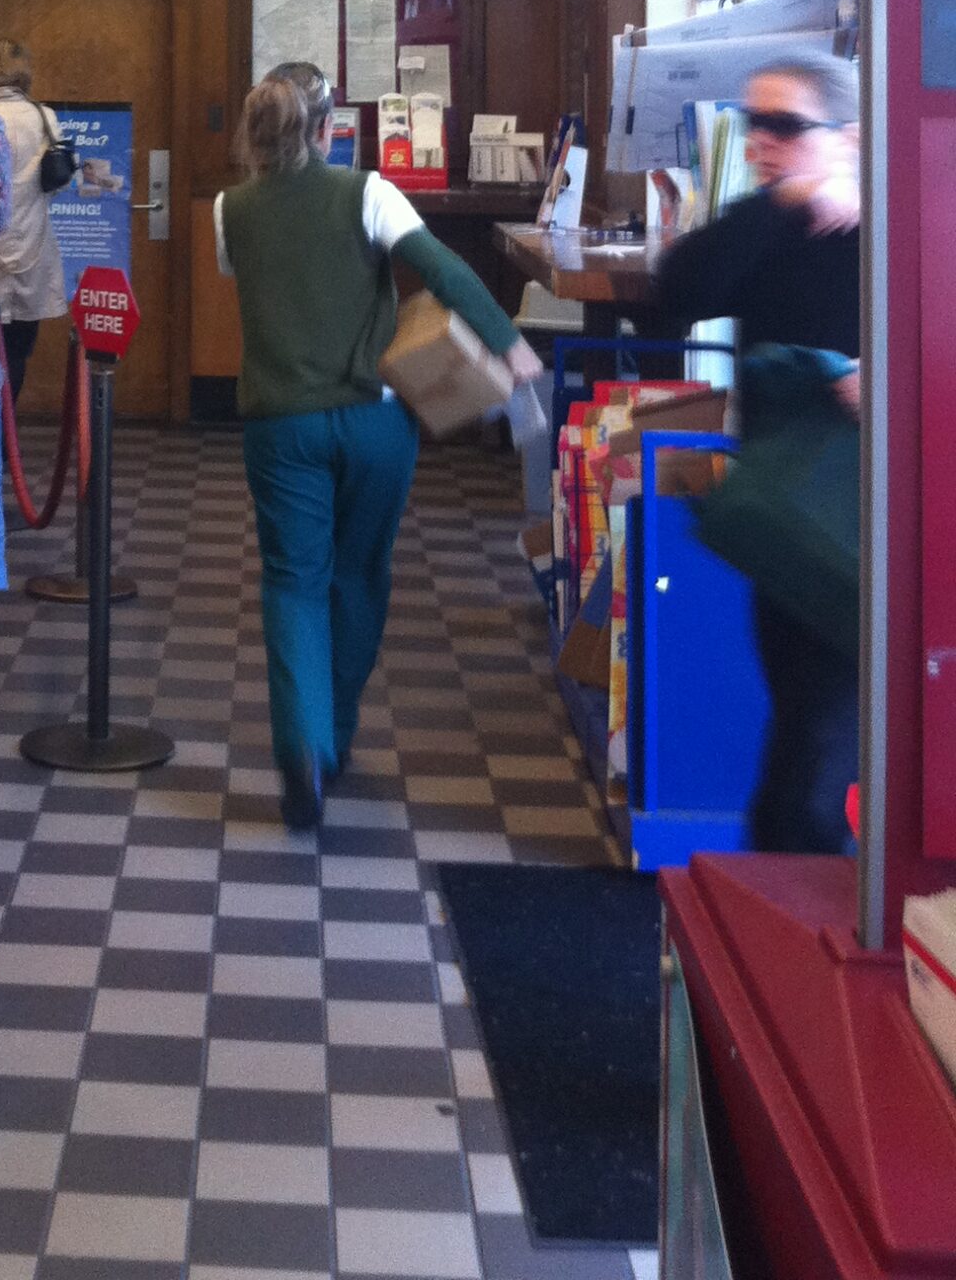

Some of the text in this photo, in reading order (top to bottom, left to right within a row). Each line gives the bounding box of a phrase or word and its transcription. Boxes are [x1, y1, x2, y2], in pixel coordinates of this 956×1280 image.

[91, 122, 101, 131] a
[75, 135, 109, 146] Box?
[80, 288, 129, 311] ENTER
[84, 313, 124, 335] HERE
